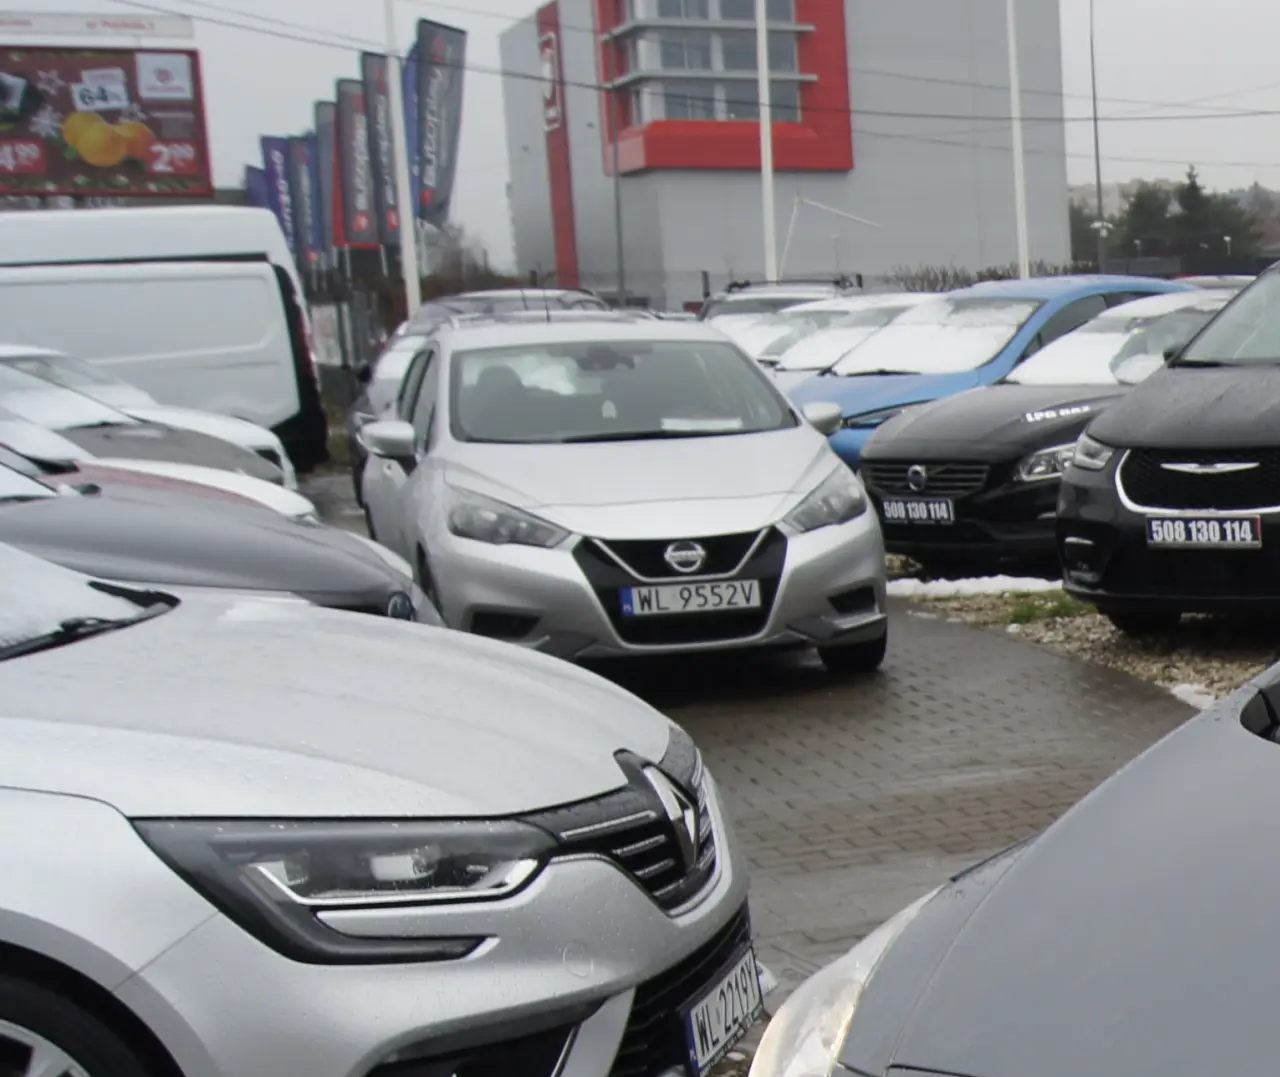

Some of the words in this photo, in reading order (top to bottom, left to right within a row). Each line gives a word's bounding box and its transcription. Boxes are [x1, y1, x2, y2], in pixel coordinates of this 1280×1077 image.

[1151, 520, 1186, 542] 508
[1188, 520, 1221, 542] 130
[1223, 520, 1253, 543] 114
[637, 588, 670, 612] WL
[679, 583, 753, 608] 9552V
[695, 1003, 720, 1058] WL
